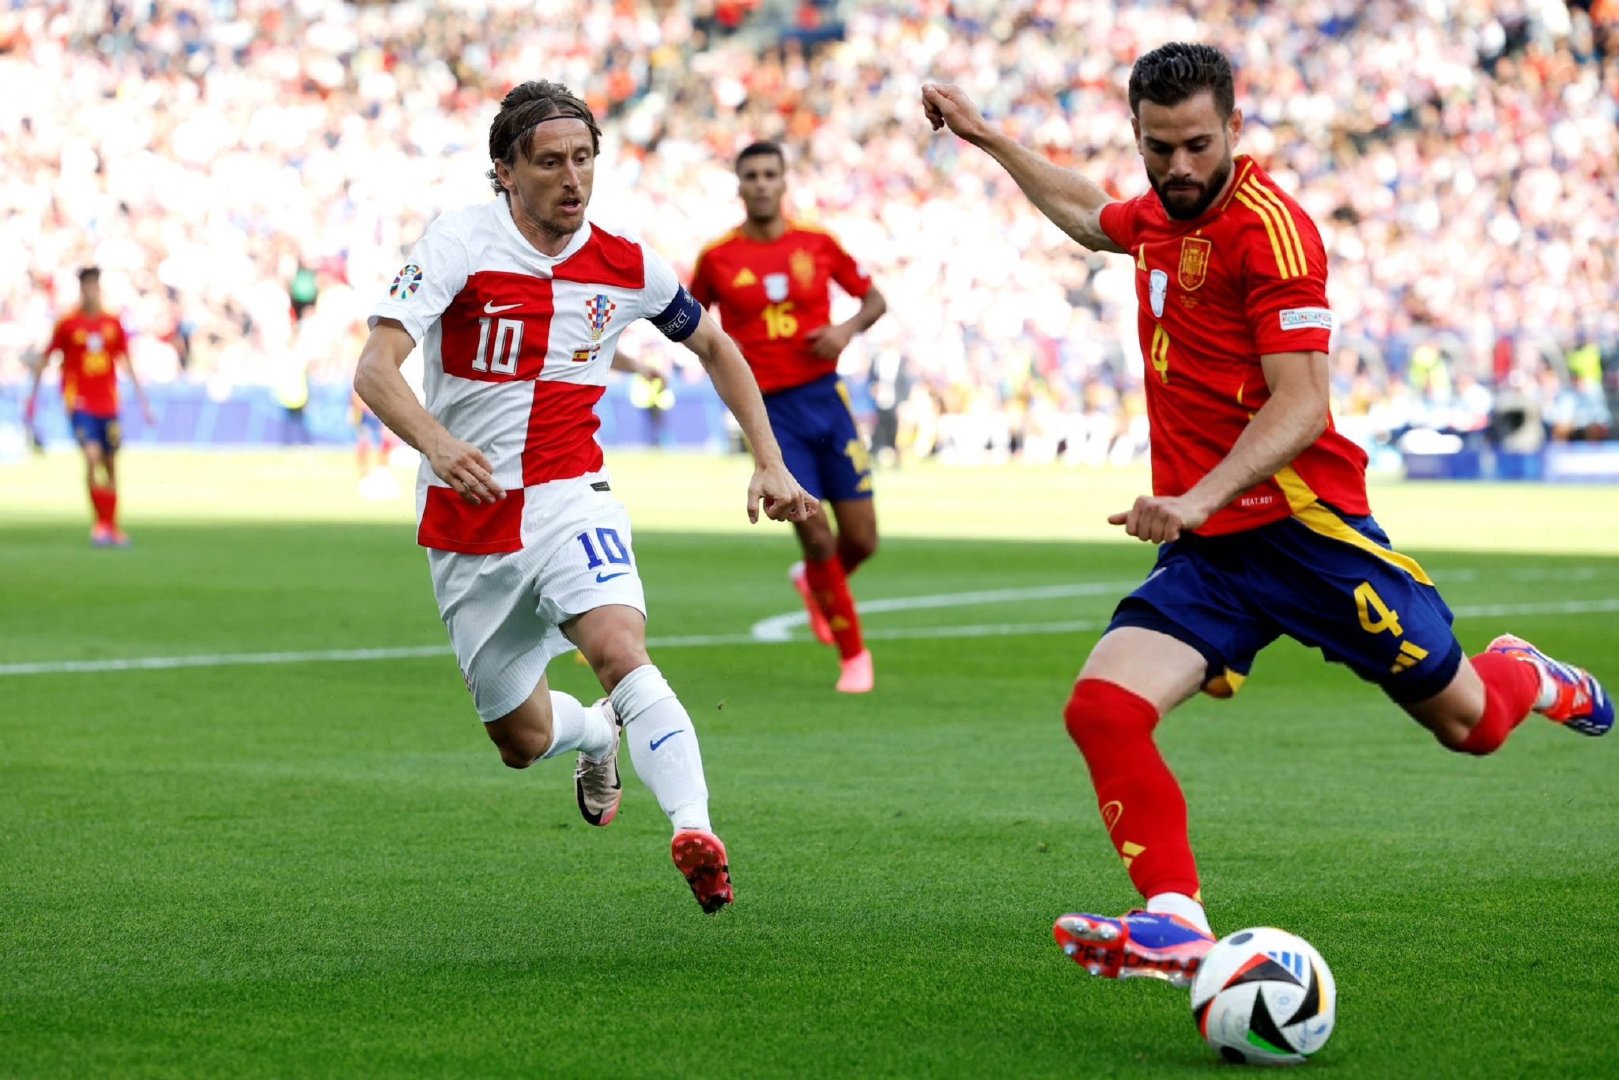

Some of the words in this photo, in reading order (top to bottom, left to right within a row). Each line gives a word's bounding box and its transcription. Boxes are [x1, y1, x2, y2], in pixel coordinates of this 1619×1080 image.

[663, 310, 688, 333] SPECT
[761, 302, 798, 340] 16
[472, 316, 524, 376] 10
[1152, 323, 1170, 384] 4
[577, 528, 631, 570] 10
[1354, 581, 1404, 637] 4
